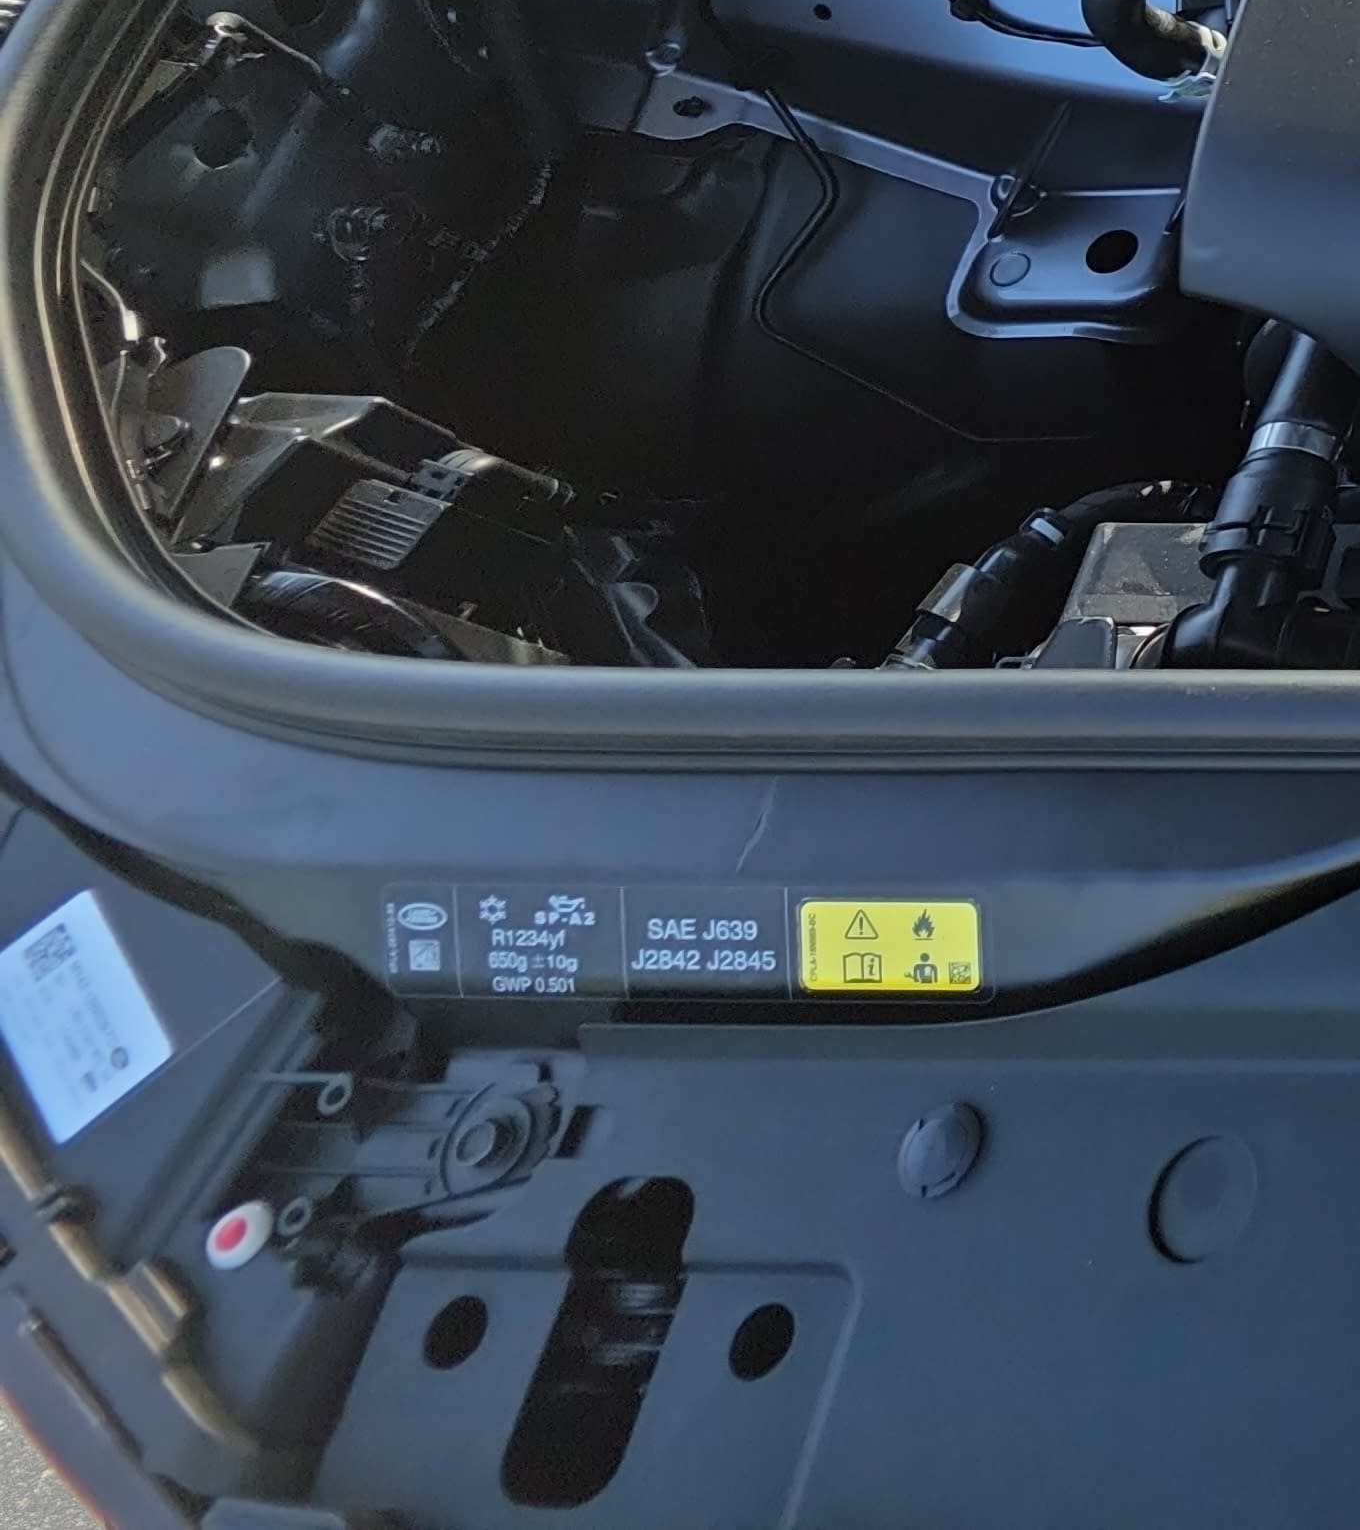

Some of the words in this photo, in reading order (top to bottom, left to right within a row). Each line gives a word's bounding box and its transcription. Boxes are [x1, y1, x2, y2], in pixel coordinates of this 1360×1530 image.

[534, 911, 597, 926] SP-A2
[647, 917, 697, 941] SAE
[701, 918, 758, 941] J639
[491, 928, 567, 951] R1234yf
[488, 951, 528, 973] 650g
[631, 948, 701, 971] J2842
[706, 949, 777, 971] J2845
[492, 975, 532, 992] GWP
[535, 976, 576, 993] 0.501
